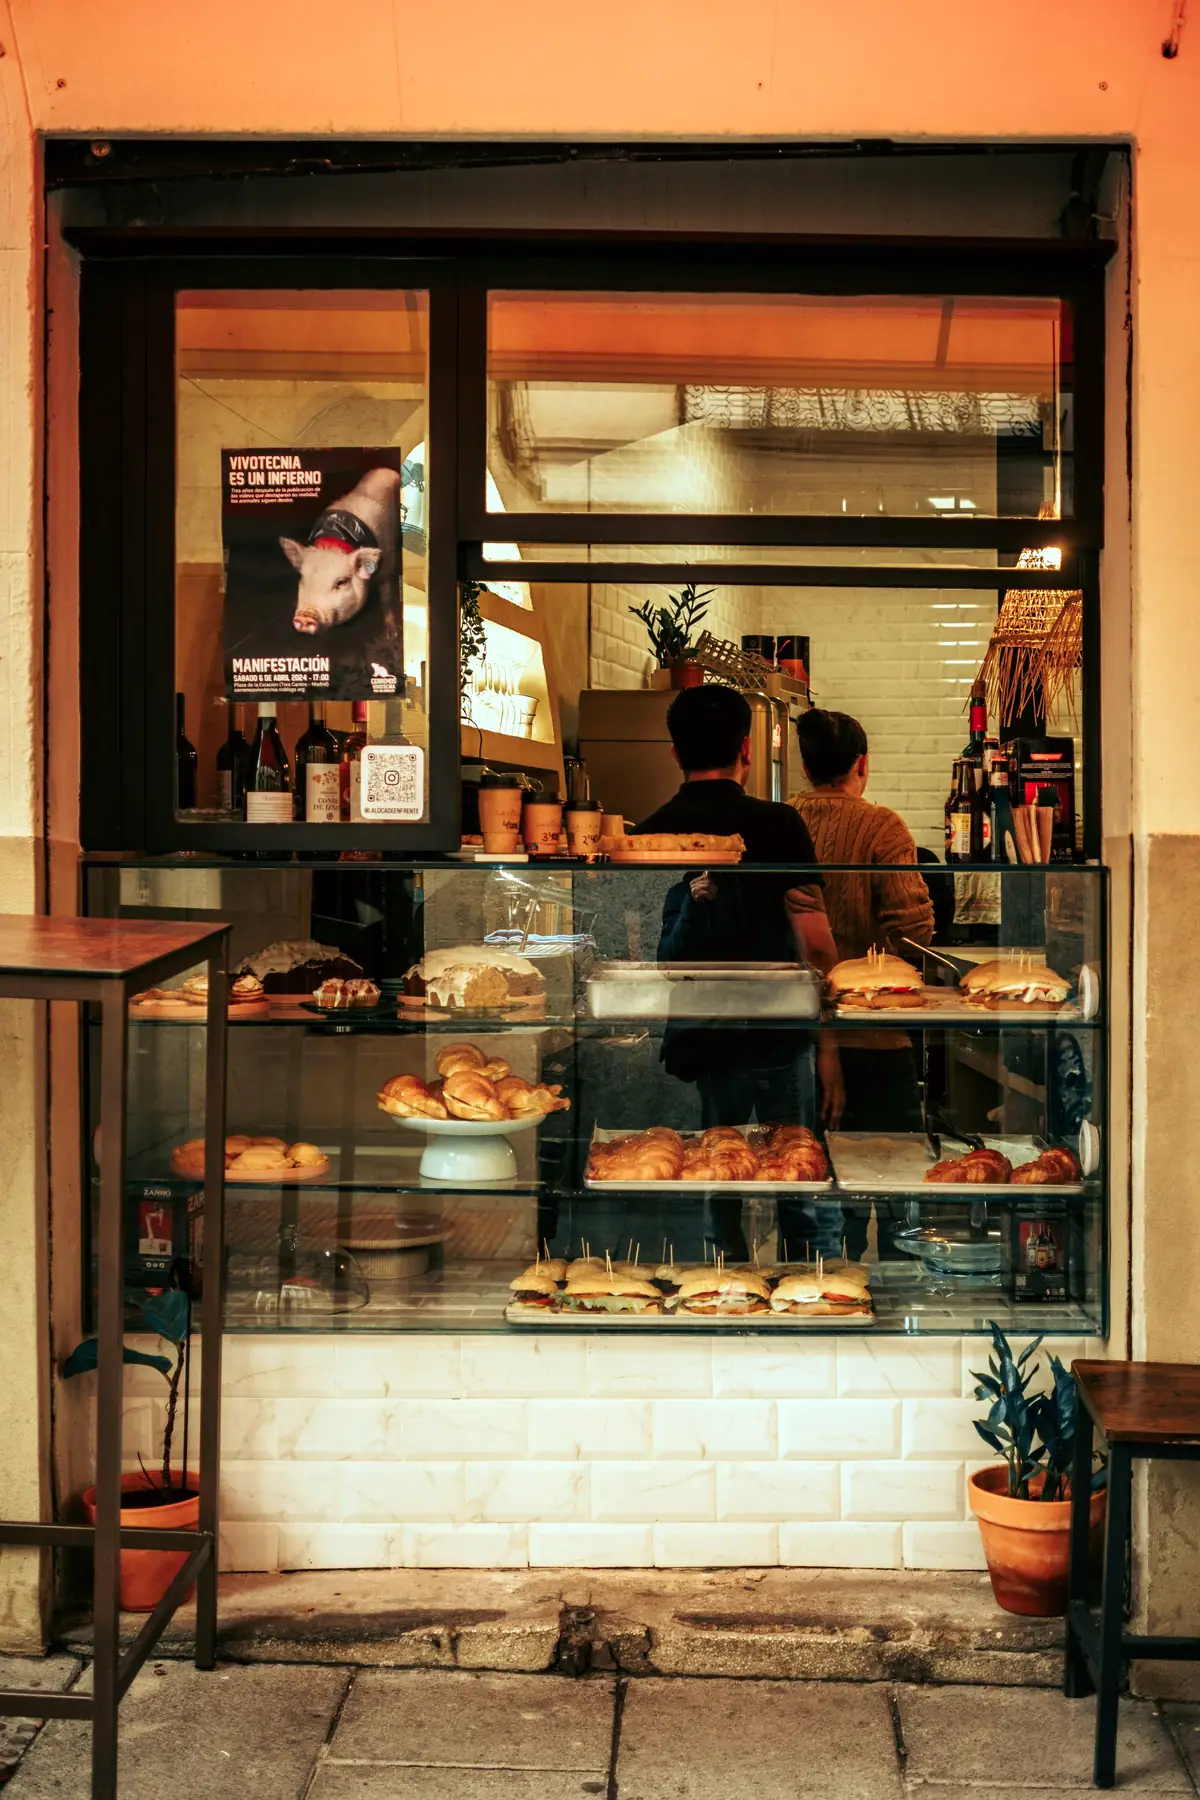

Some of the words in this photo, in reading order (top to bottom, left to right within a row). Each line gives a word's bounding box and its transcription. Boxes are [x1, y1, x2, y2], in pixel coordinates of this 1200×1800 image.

[229, 455, 301, 470] VIVOTECNIA
[229, 471, 245, 486] ES
[247, 471, 265, 485] UN
[267, 470, 321, 485] INFIERNO
[232, 654, 329, 673] MANIFESTACIÓN
[233, 672, 258, 682] SÁBADO
[258, 674, 264, 682] 6
[291, 673, 308, 681] 2024
[312, 673, 330, 681] 17:00
[143, 1189, 172, 1197] ZARRO
[187, 1190, 205, 1212] ZAR
